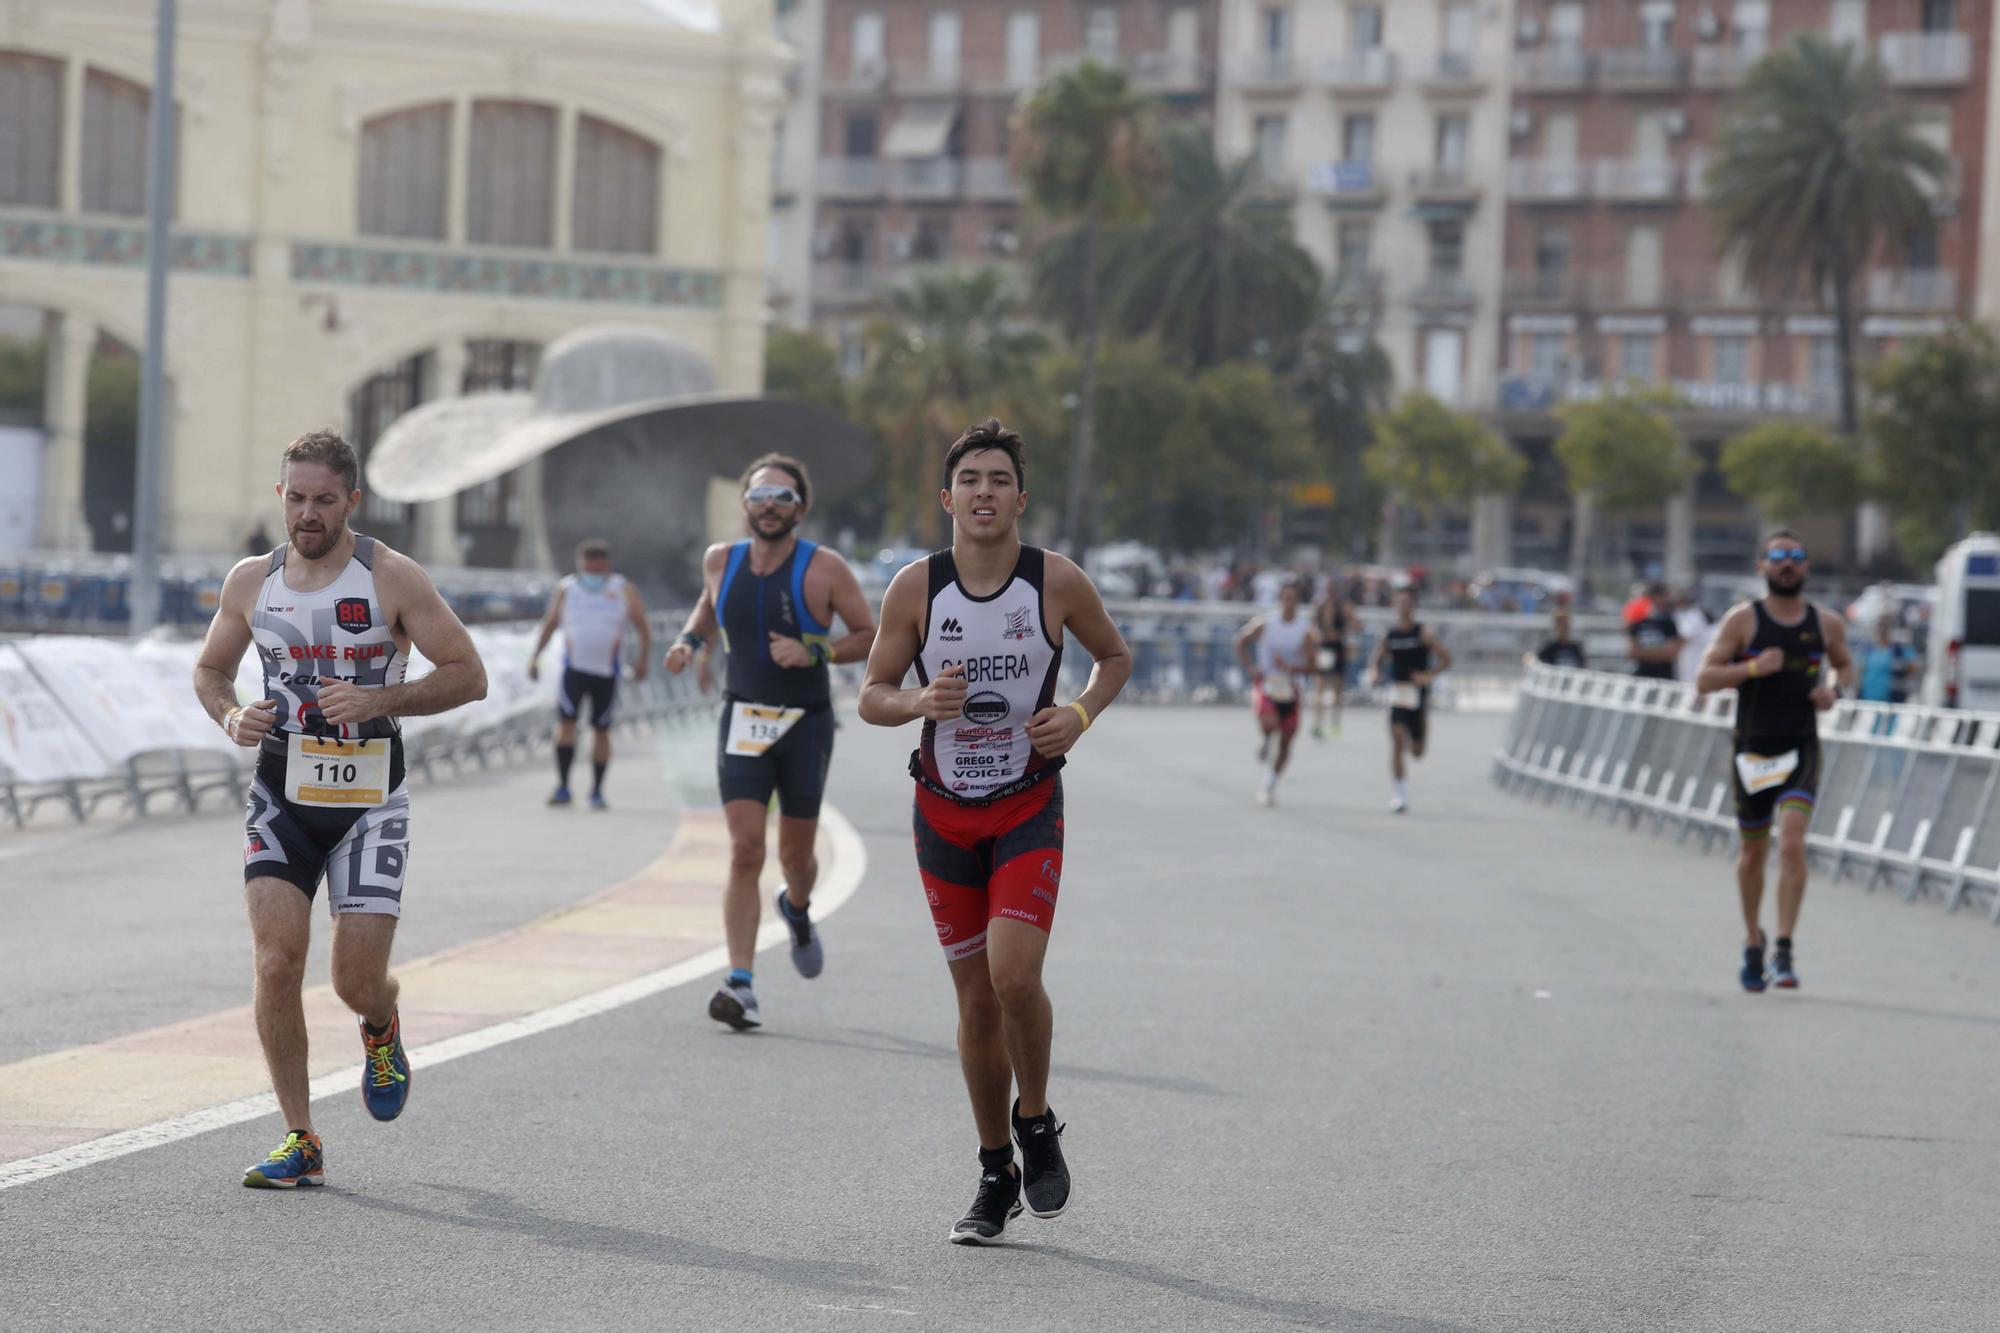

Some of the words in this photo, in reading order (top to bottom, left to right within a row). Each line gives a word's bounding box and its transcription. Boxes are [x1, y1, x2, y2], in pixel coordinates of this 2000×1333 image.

[338, 602, 367, 623] BR
[288, 645, 337, 661] BIKE
[343, 645, 385, 661] RUN
[941, 653, 1030, 683] CABRERA
[955, 755, 995, 766] GREGO
[314, 762, 357, 783] 110
[952, 767, 1013, 779] VOICE
[1000, 907, 1039, 922] mobel
